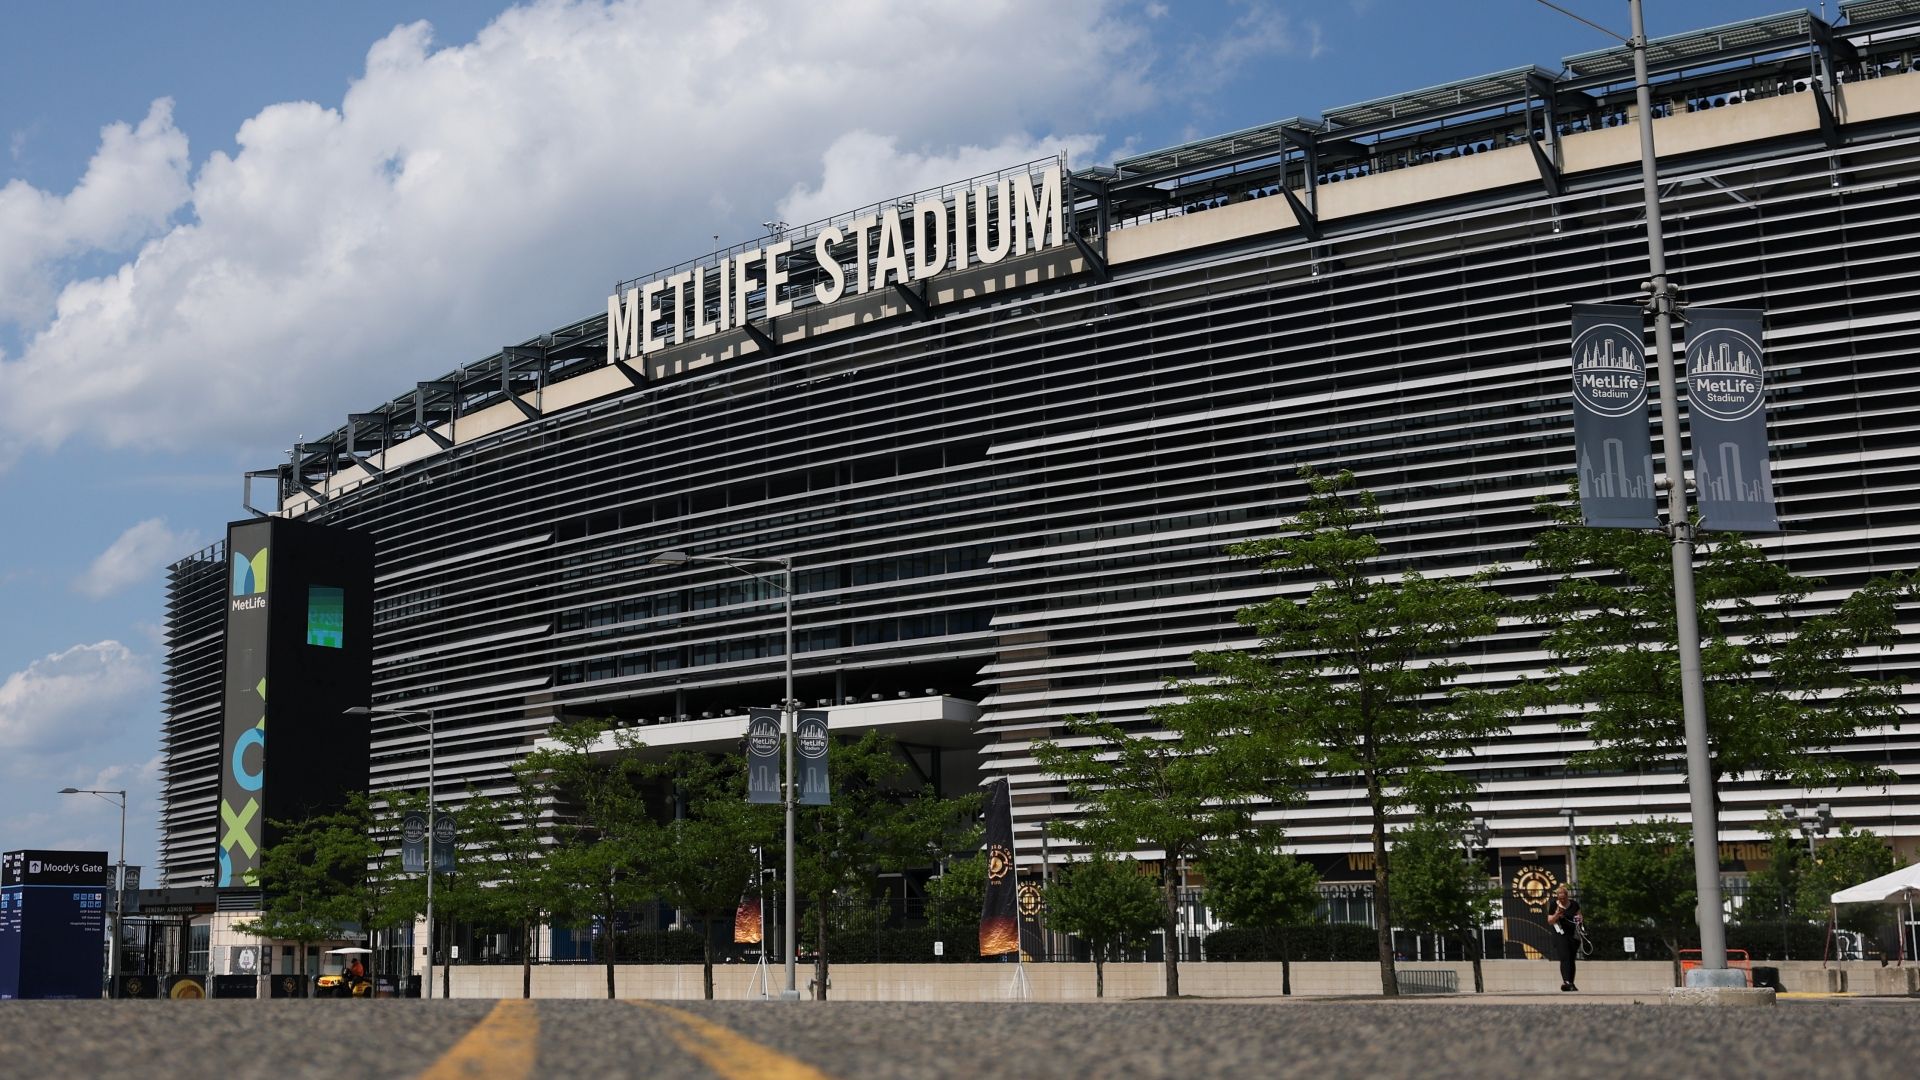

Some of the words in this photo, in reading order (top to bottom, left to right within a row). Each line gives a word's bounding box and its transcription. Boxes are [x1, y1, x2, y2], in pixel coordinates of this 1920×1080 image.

[607, 240, 794, 365] METLIFE
[815, 165, 1064, 305] STADIUM
[1582, 374, 1639, 389] MetLife
[1697, 378, 1755, 393] MetLife
[1592, 389, 1629, 399] Stadium
[1707, 393, 1745, 403] Stadium
[232, 596, 266, 611] MetLife
[752, 737, 776, 745] MetLife
[800, 739, 825, 747] MetLife
[43, 863, 80, 875] Moody's
[82, 863, 103, 873] Gate
